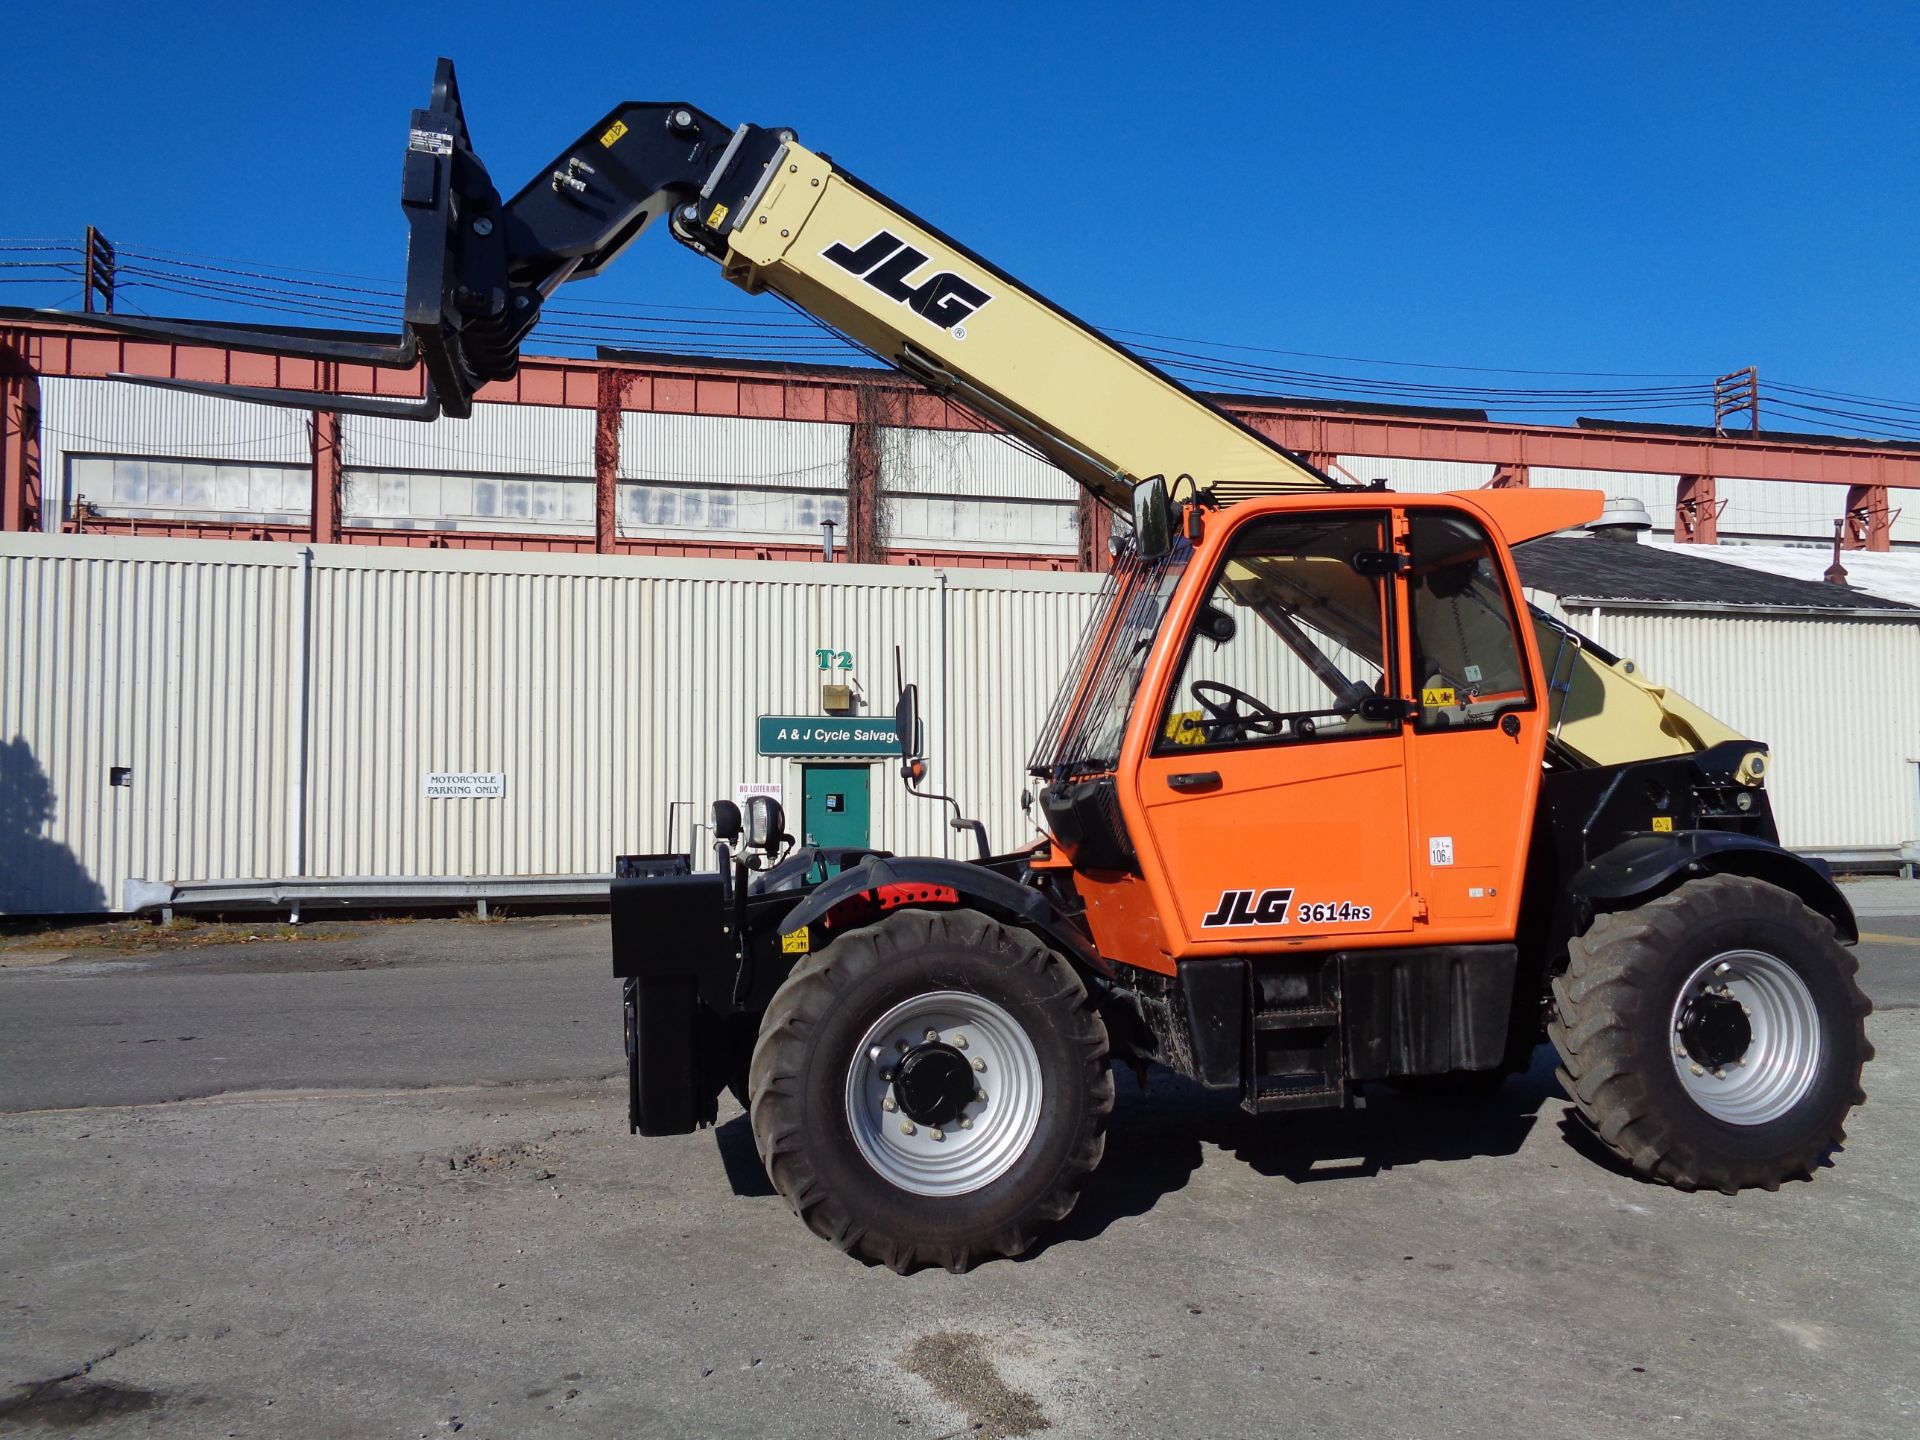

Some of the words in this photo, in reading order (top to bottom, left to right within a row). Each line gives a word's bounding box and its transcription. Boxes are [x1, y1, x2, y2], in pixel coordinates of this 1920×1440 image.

[819, 229, 995, 331] JLG
[815, 648, 853, 671] T2
[777, 729, 787, 740] A
[791, 729, 800, 740] &
[803, 729, 811, 740] J
[815, 729, 850, 743] Cycle
[430, 775, 496, 784] MOTORCYCLE
[427, 786, 471, 794] PARKING
[475, 786, 499, 794] ONLY
[739, 785, 748, 793] NO
[750, 784, 780, 793] LOITERING
[1432, 848, 1446, 863] 106
[1202, 889, 1292, 927] JLG
[1298, 902, 1371, 924] 3614RS
